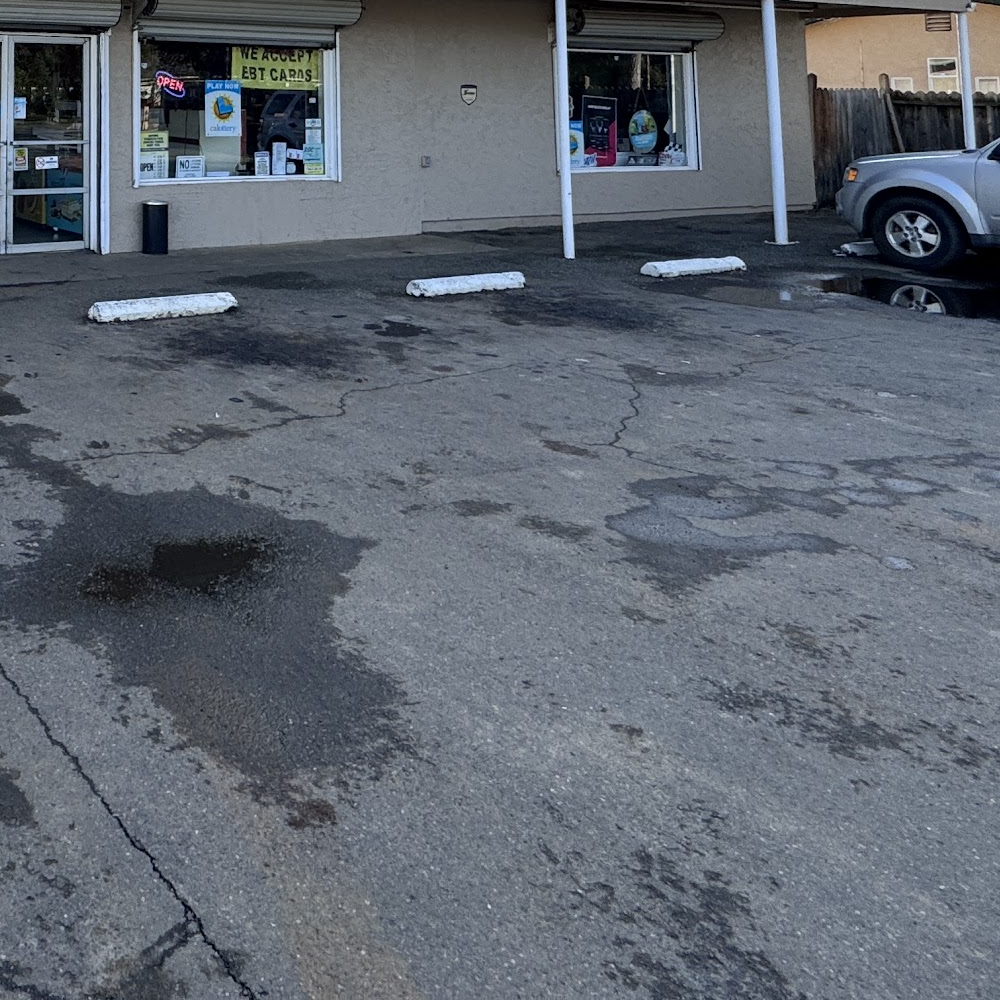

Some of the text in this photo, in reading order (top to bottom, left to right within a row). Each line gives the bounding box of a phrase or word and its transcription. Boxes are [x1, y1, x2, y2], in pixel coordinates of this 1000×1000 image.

[240, 46, 314, 63] WE ACCEPT
[241, 66, 312, 82] EBT CARDS
[156, 75, 184, 92] OPEN
[140, 163, 154, 172] OPEN
[179, 160, 190, 170] NO
